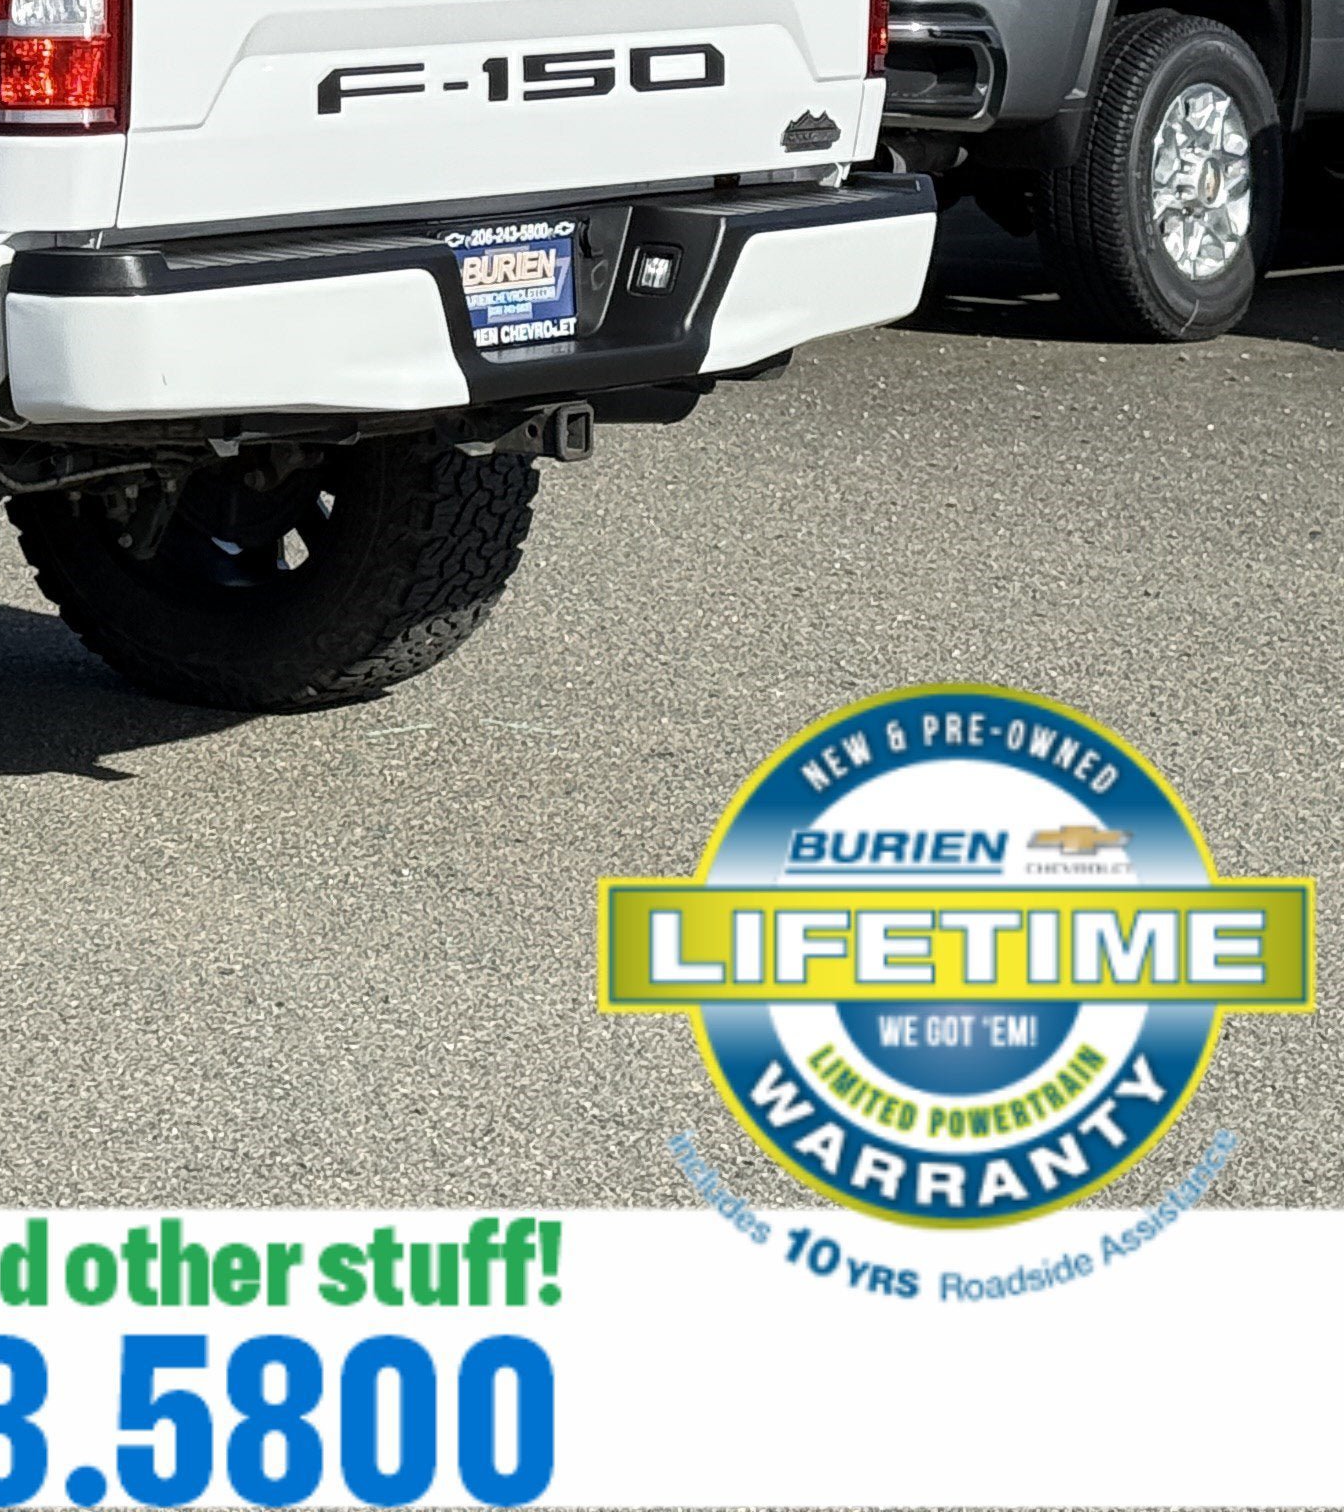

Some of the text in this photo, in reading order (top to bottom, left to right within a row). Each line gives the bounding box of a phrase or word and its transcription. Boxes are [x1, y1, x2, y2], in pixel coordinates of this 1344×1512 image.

[317, 43, 726, 115] F-150
[471, 222, 549, 246] 206-243-5800
[462, 248, 557, 285] BURIEN
[500, 317, 578, 344] CHEVROLET
